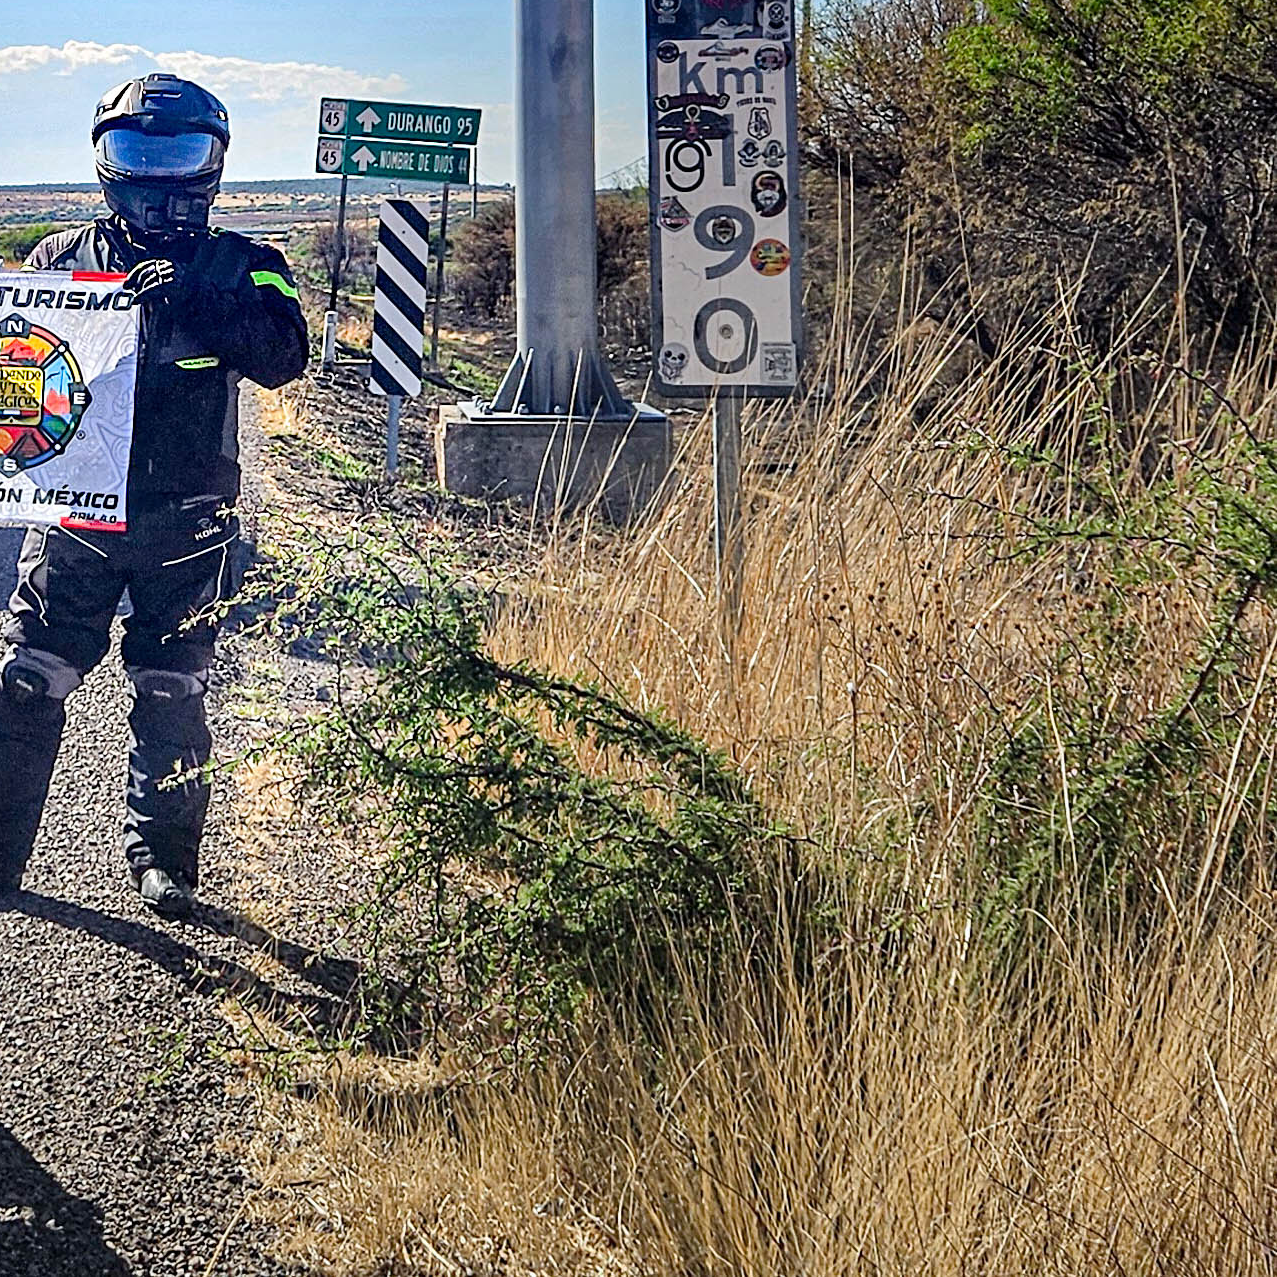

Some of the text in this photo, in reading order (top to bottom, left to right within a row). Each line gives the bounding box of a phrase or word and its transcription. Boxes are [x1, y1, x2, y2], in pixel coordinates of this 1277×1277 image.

[325, 111, 340, 127] 45
[387, 111, 472, 137] DURANGO 95
[321, 150, 337, 166] 45
[379, 150, 415, 171] NOMBRE
[417, 153, 430, 172] DE
[433, 154, 455, 174] DIOS
[7, 320, 24, 333] N
[73, 392, 86, 405] E
[3, 459, 18, 472] S
[32, 484, 119, 510] MÉXICO
[194, 525, 223, 541] KOHL
